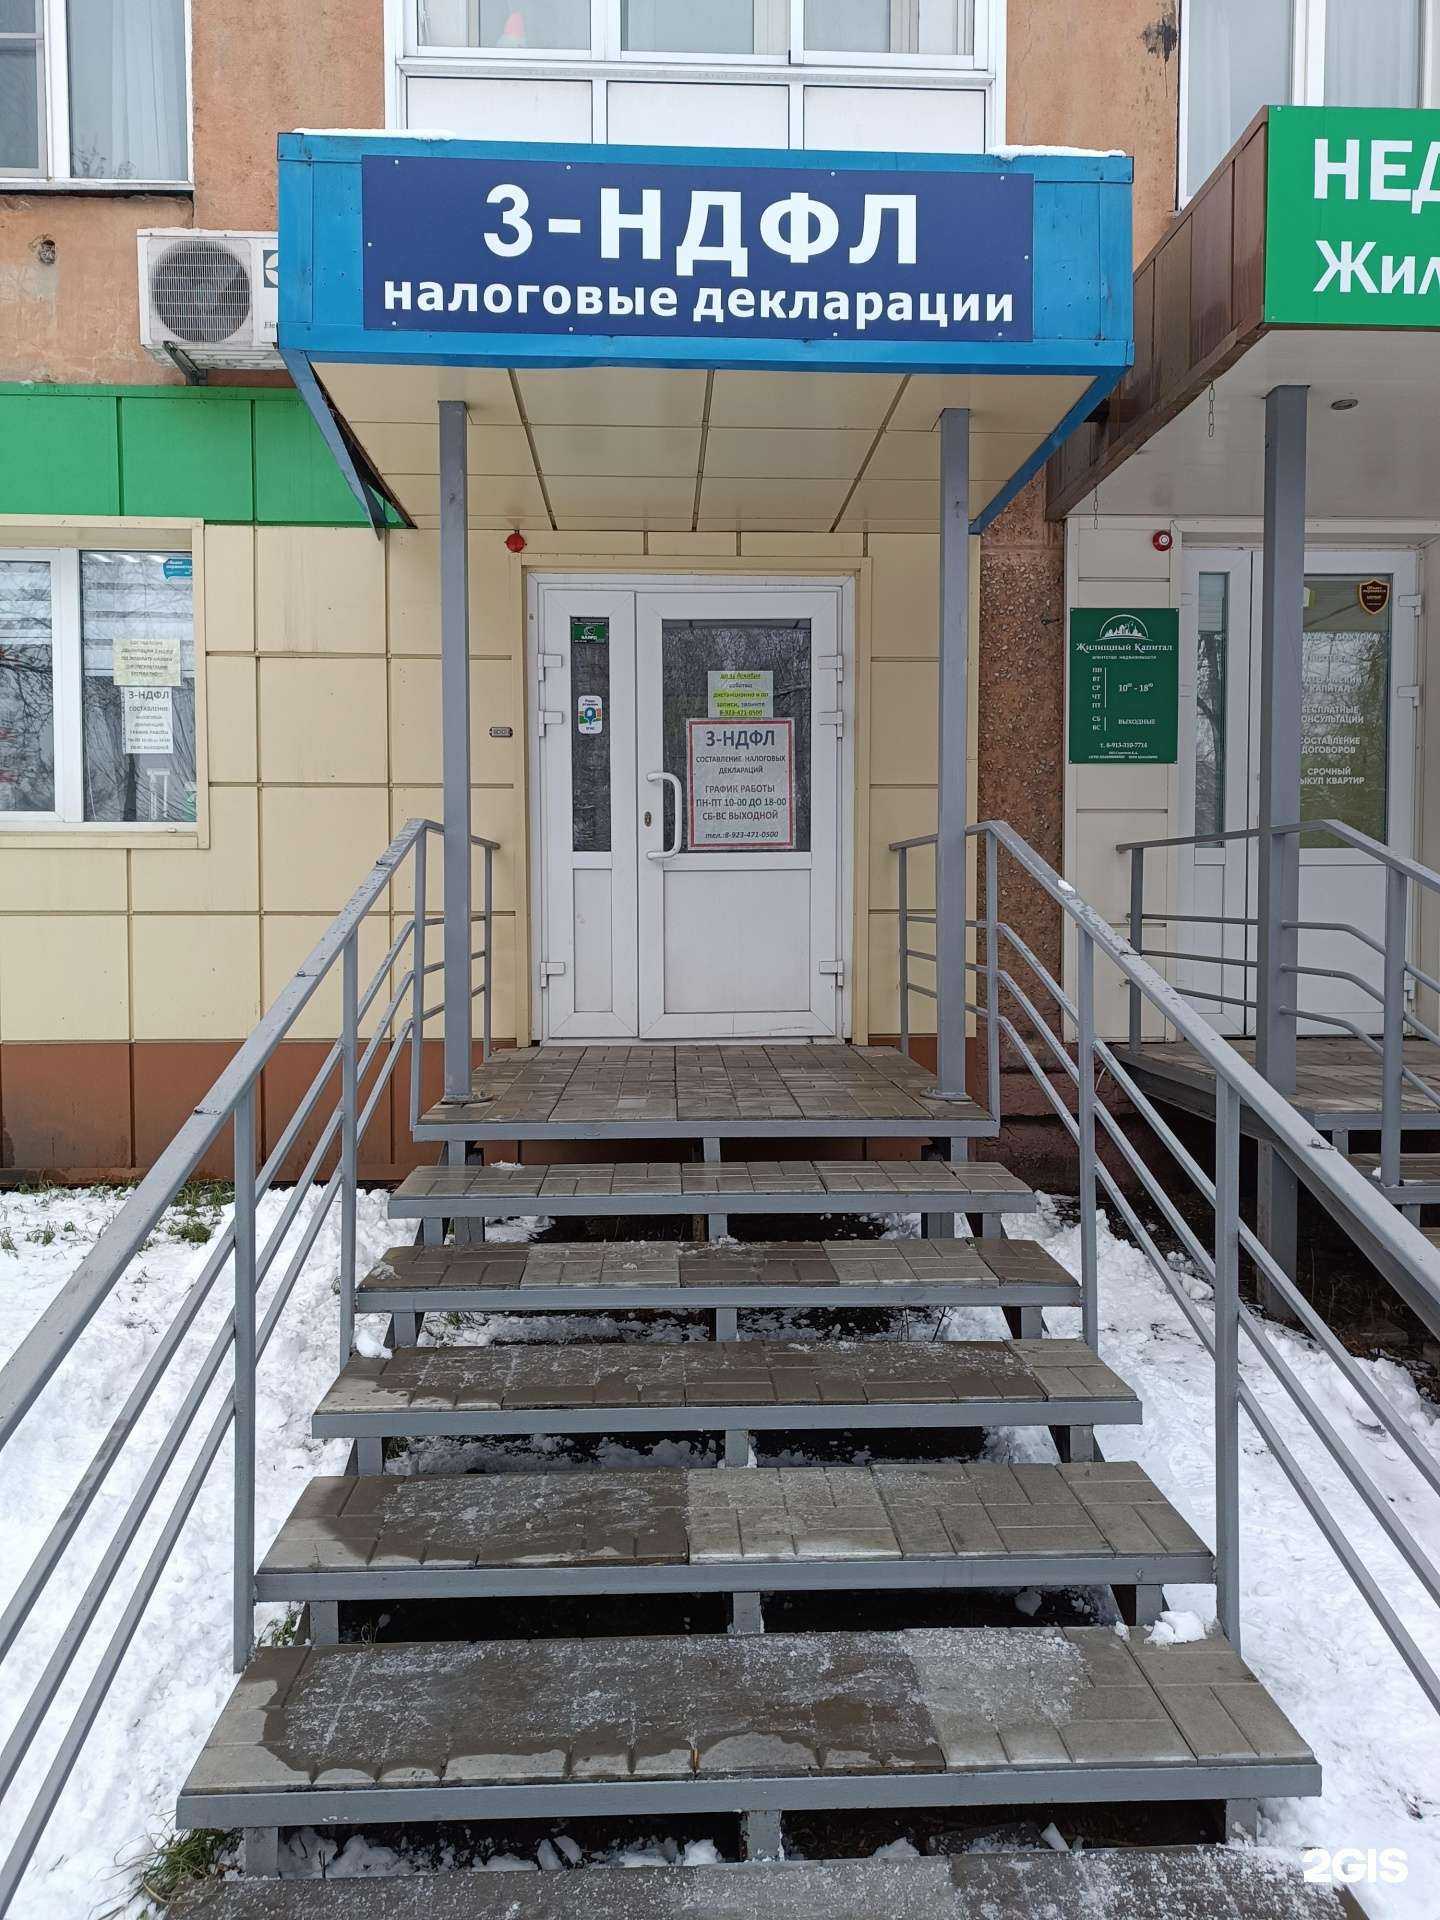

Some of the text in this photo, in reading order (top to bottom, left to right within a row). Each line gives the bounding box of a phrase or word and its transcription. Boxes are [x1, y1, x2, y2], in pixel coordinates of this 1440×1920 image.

[483, 183, 919, 278] 3-НДФЛ
[384, 280, 1014, 330] налоговые декларации
[1076, 643, 1173, 653] Жилищный Капитал
[1301, 715, 1364, 724] ОНСУЛЬТАЦИИ
[705, 730, 775, 750] 3-НДФЛ
[1300, 736, 1361, 744] ОСТАВЛЕНИЕ
[696, 754, 786, 763] СОСТАВЛЕНИЕ НАЛОГОВЫХ
[718, 765, 764, 775] ДЕКЛАРАЦИЙ
[1307, 766, 1351, 776] СРОЧНЫЙ
[1326, 776, 1365, 785] КВАРТИР
[705, 784, 775, 794] ГРАФИК РАБОТЫ
[696, 798, 787, 808] ПН-ПТ 10-00 ДО 18-00
[702, 810, 779, 821] СБ-ВС ВЫХОДНОЙ
